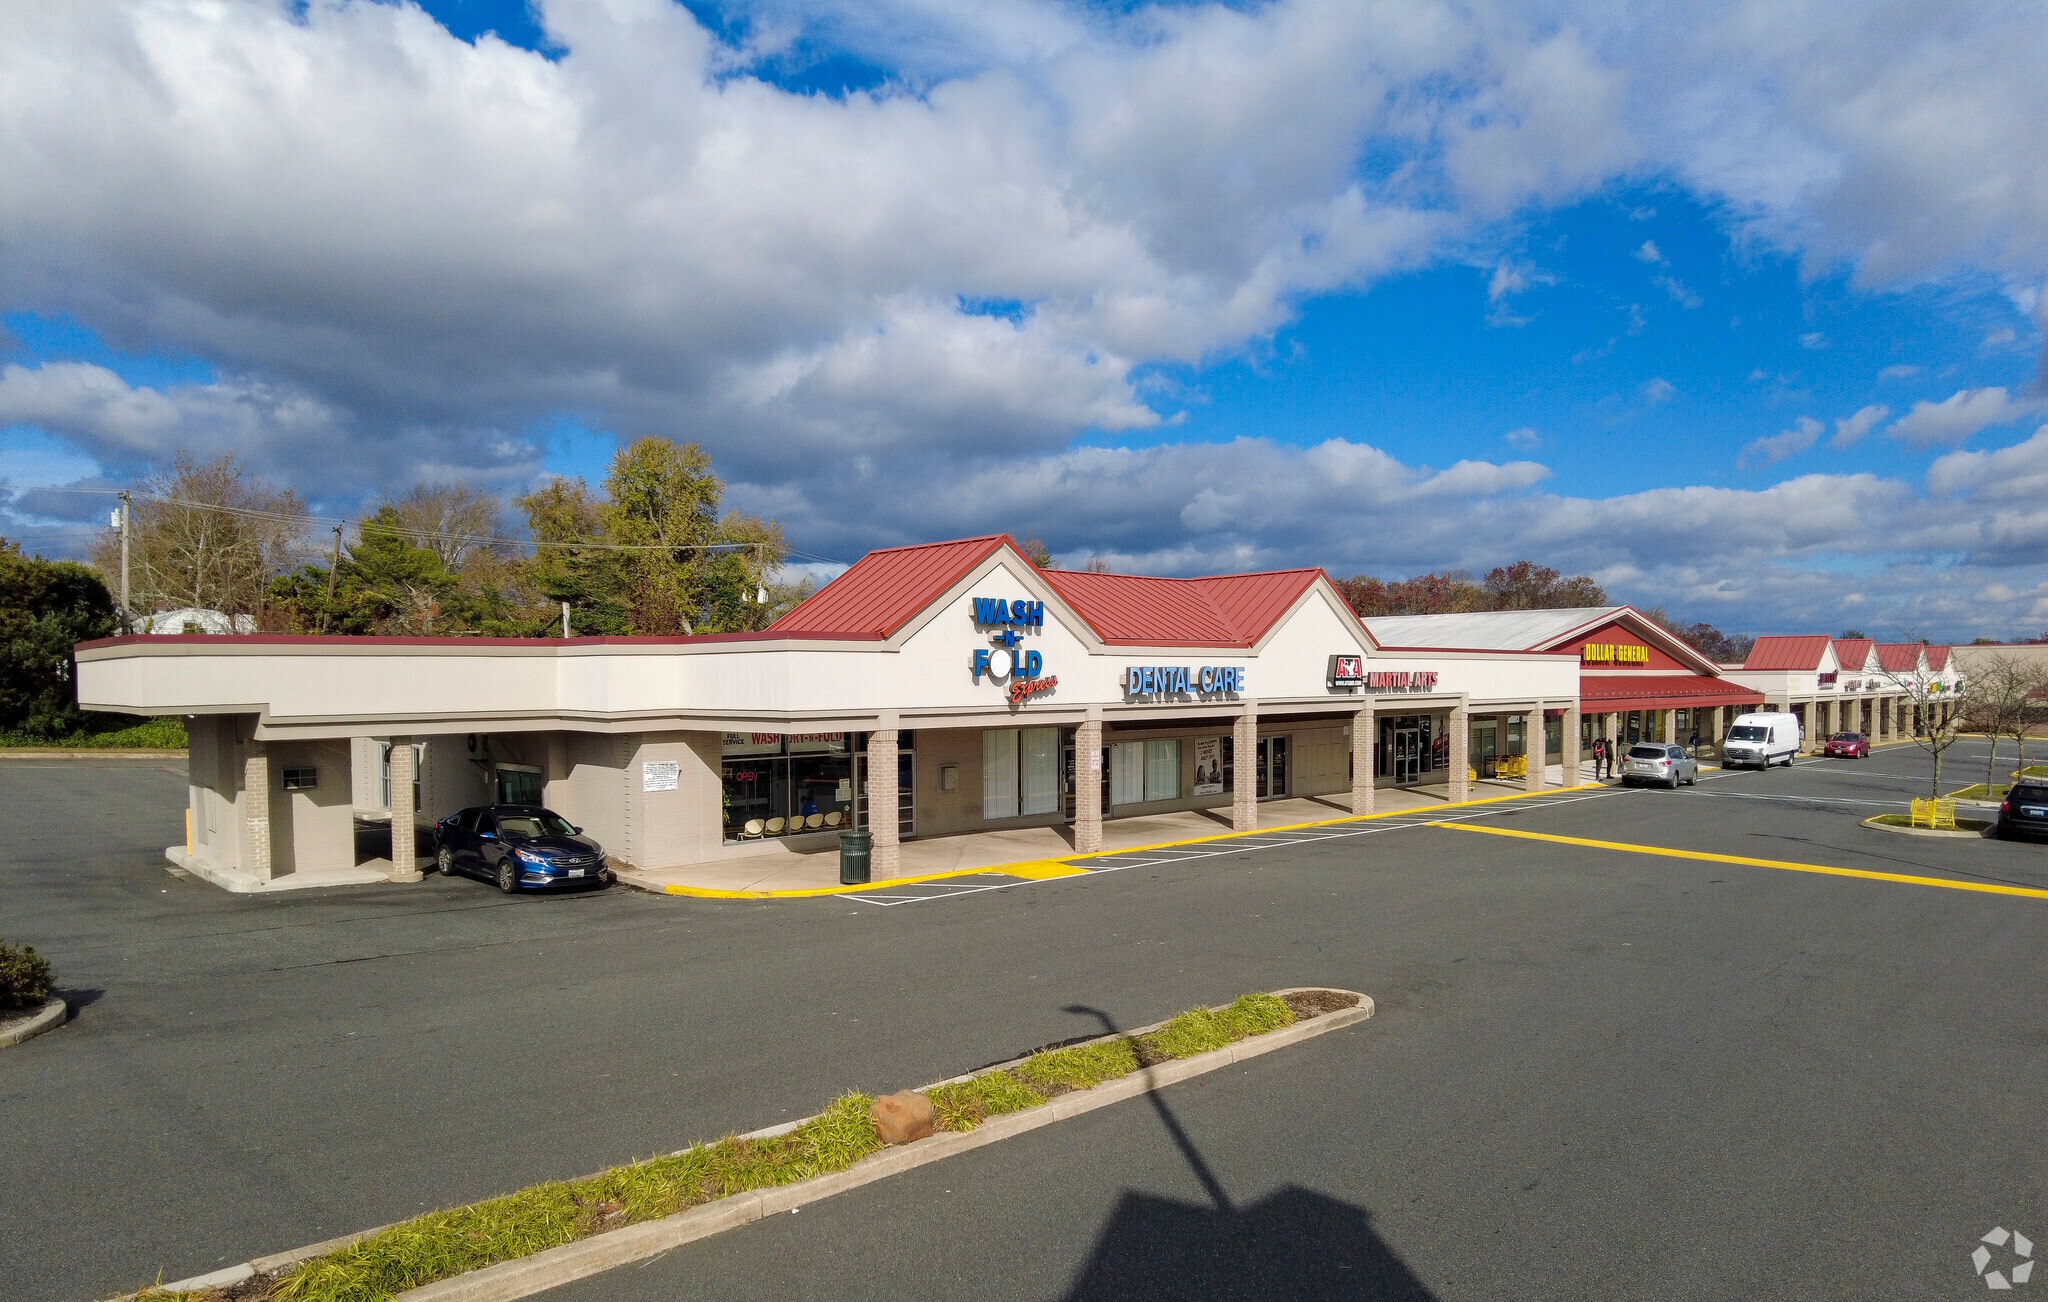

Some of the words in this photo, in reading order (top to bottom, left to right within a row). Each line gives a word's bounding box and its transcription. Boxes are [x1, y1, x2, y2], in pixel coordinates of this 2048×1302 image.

[974, 597, 1044, 627] WASH
[1585, 643, 1615, 661] DOLLAR
[1618, 645, 1649, 662] GENERAL
[975, 649, 1043, 678] FOLD
[1129, 666, 1196, 694] DENTAL
[1202, 665, 1245, 693] CARE
[1370, 672, 1413, 688] MARTIAL
[1415, 672, 1438, 687] ARTS
[1011, 676, 1058, 704] Express
[722, 738, 745, 746] SERVICE
[751, 732, 780, 745] WASH
[736, 771, 758, 781] OPEN
